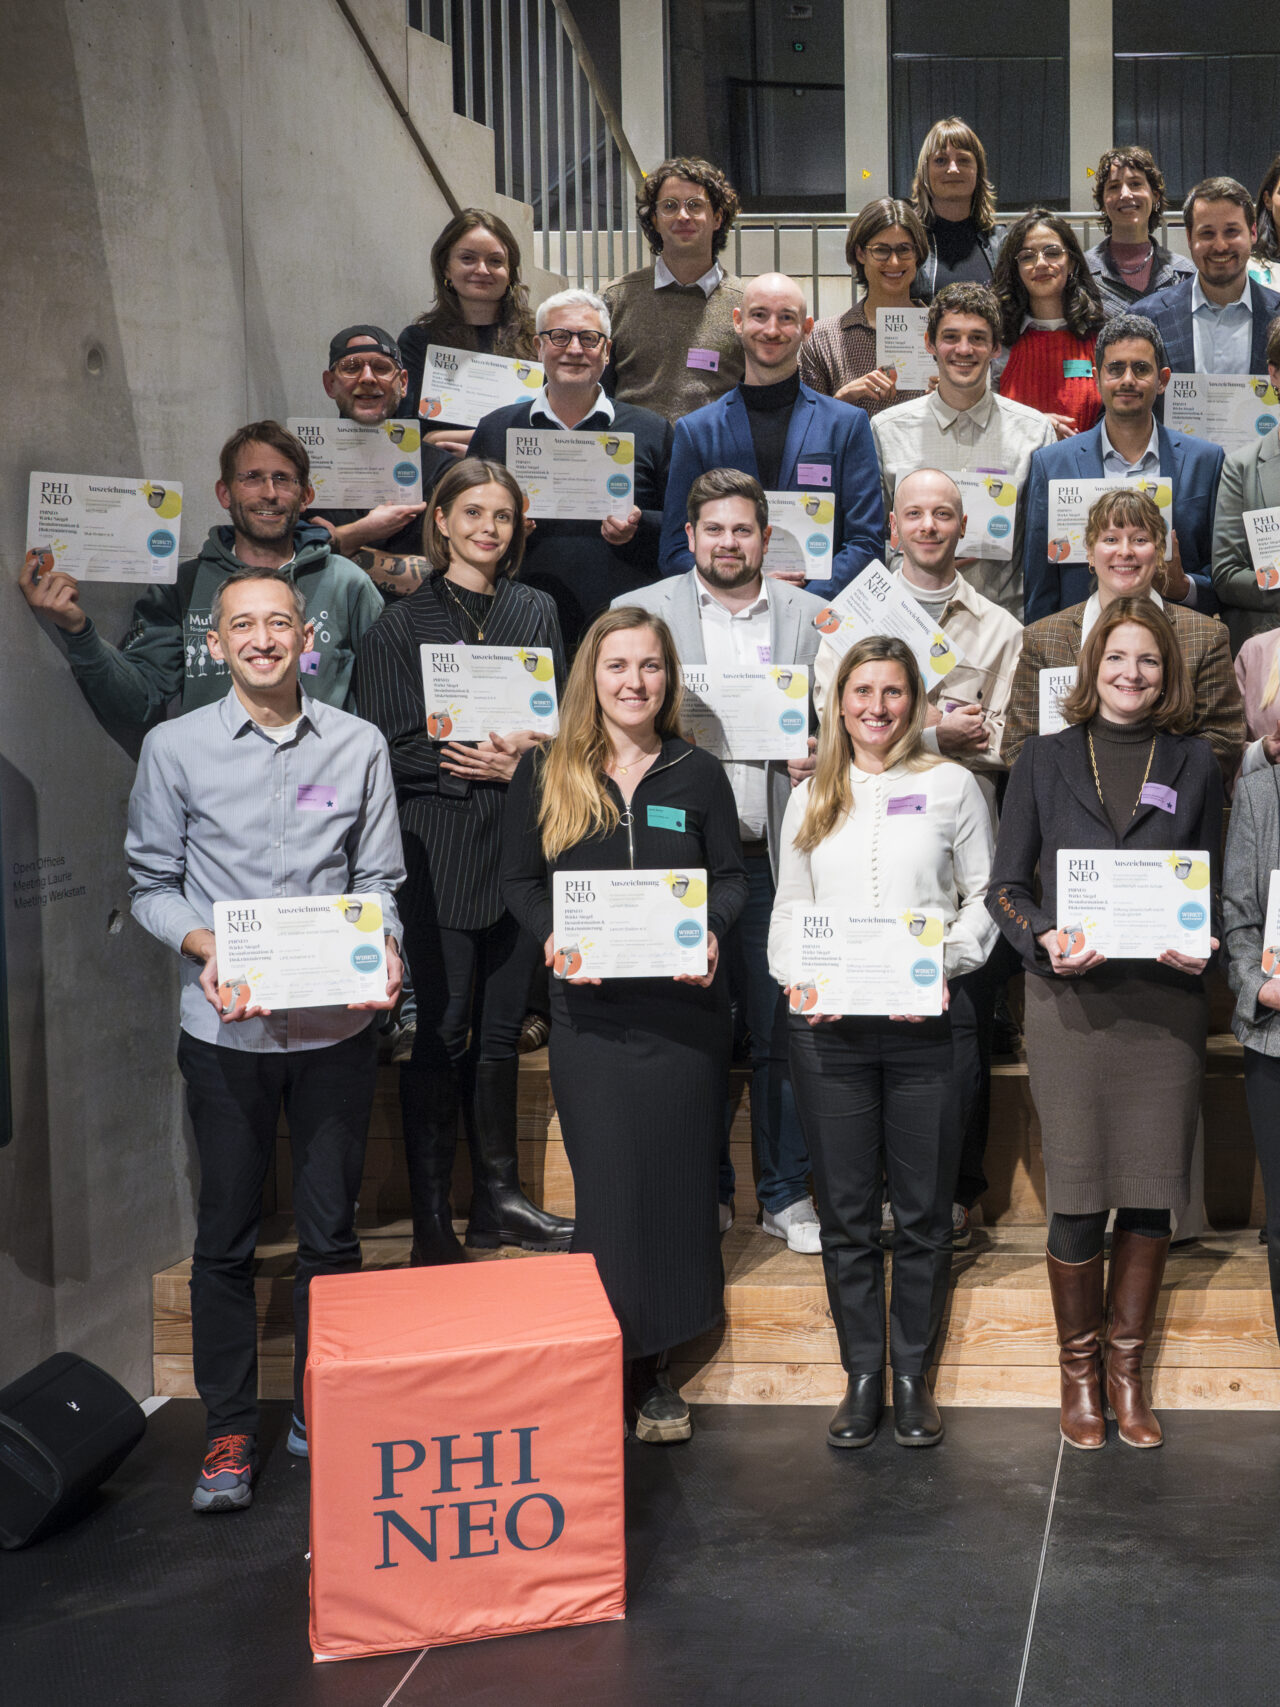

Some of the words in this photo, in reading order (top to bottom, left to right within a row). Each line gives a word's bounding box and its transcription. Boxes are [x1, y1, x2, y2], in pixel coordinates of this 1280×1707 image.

[884, 314, 904, 323] PHI
[884, 323, 907, 332] NEO
[435, 352, 457, 362] PHI
[434, 359, 458, 371] NEO
[1173, 380, 1194, 389] PHI
[1172, 389, 1197, 398] NEO
[297, 426, 320, 435] PHI
[297, 435, 324, 445] NEO
[516, 437, 538, 446] PHI
[515, 446, 542, 456] NEO
[41, 482, 69, 494] PHI
[87, 484, 136, 495] Auszeichnung
[1057, 486, 1079, 495] PHI
[40, 493, 72, 505] NEO
[1057, 495, 1082, 504] NEO
[1252, 514, 1275, 525] PHI
[1254, 523, 1280, 534] NEO
[870, 570, 892, 594] PHI
[863, 577, 888, 603] NEO
[431, 653, 455, 662] PHI
[470, 653, 513, 661] Auszeichnung
[432, 663, 459, 673] NEO
[681, 673, 705, 682] PHI
[681, 683, 709, 692] NEO
[13, 862, 36, 875] Open
[36, 856, 66, 870] Offices
[1068, 859, 1095, 870] PHI
[1114, 859, 1162, 867] Auszeichnung
[13, 878, 46, 891] Meeting
[48, 871, 73, 885] Laurie
[1068, 871, 1099, 882] NEO
[565, 880, 592, 891] PHI
[14, 894, 48, 909] Meeting
[49, 886, 86, 902] Werkstatt
[564, 892, 596, 903] NEO
[226, 909, 256, 921] PHI
[276, 905, 330, 914] Auszeichnung
[803, 916, 830, 927] PHI
[848, 916, 897, 924] Auszeichnung
[227, 920, 261, 933] NEO
[802, 927, 833, 938] NEO
[372, 1426, 540, 1501] PHI
[373, 1493, 565, 1570] NEO
